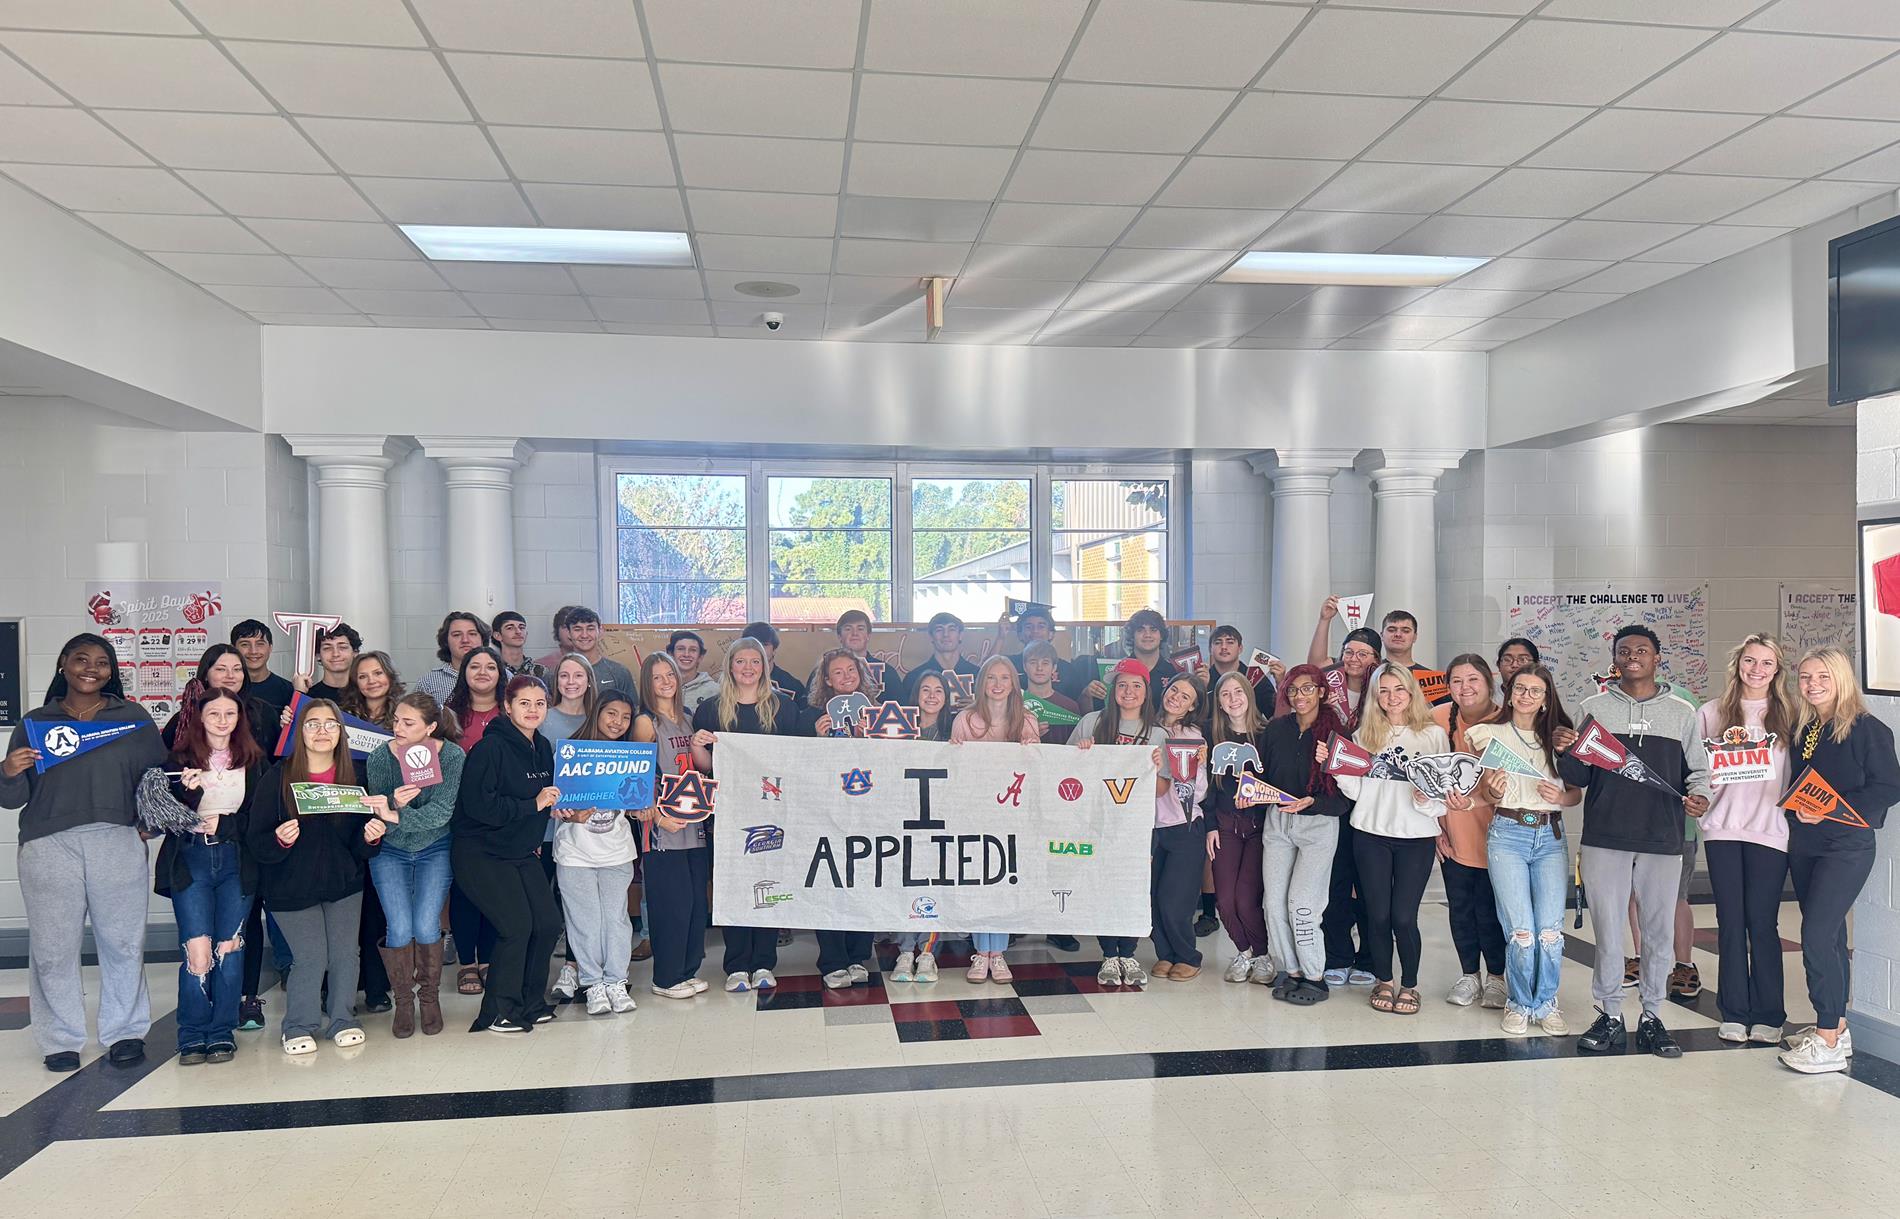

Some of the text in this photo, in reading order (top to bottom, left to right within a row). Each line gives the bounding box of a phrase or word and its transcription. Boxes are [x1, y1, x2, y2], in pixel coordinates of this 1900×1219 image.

[120, 595, 191, 616] Spirit Days
[1517, 594, 1689, 605] I ACCEPT THE CHALLENGE TO LIVE
[1788, 594, 1856, 603] I ACCEPT THE
[142, 610, 168, 623] 2025
[837, 699, 852, 714] A
[1222, 747, 1238, 761] A
[1713, 749, 1770, 769] AUM
[559, 760, 650, 777] AAC BOUND
[997, 772, 1025, 807] A
[1059, 783, 1082, 800] W
[1102, 777, 1139, 804] V
[1255, 781, 1280, 797] NORTH
[1799, 782, 1834, 806] AUM
[903, 768, 948, 829] I
[1049, 842, 1093, 855] UAB
[804, 834, 1018, 888] APPLIED!
[1052, 889, 1072, 914] T
[1296, 908, 1314, 946] OAHU
